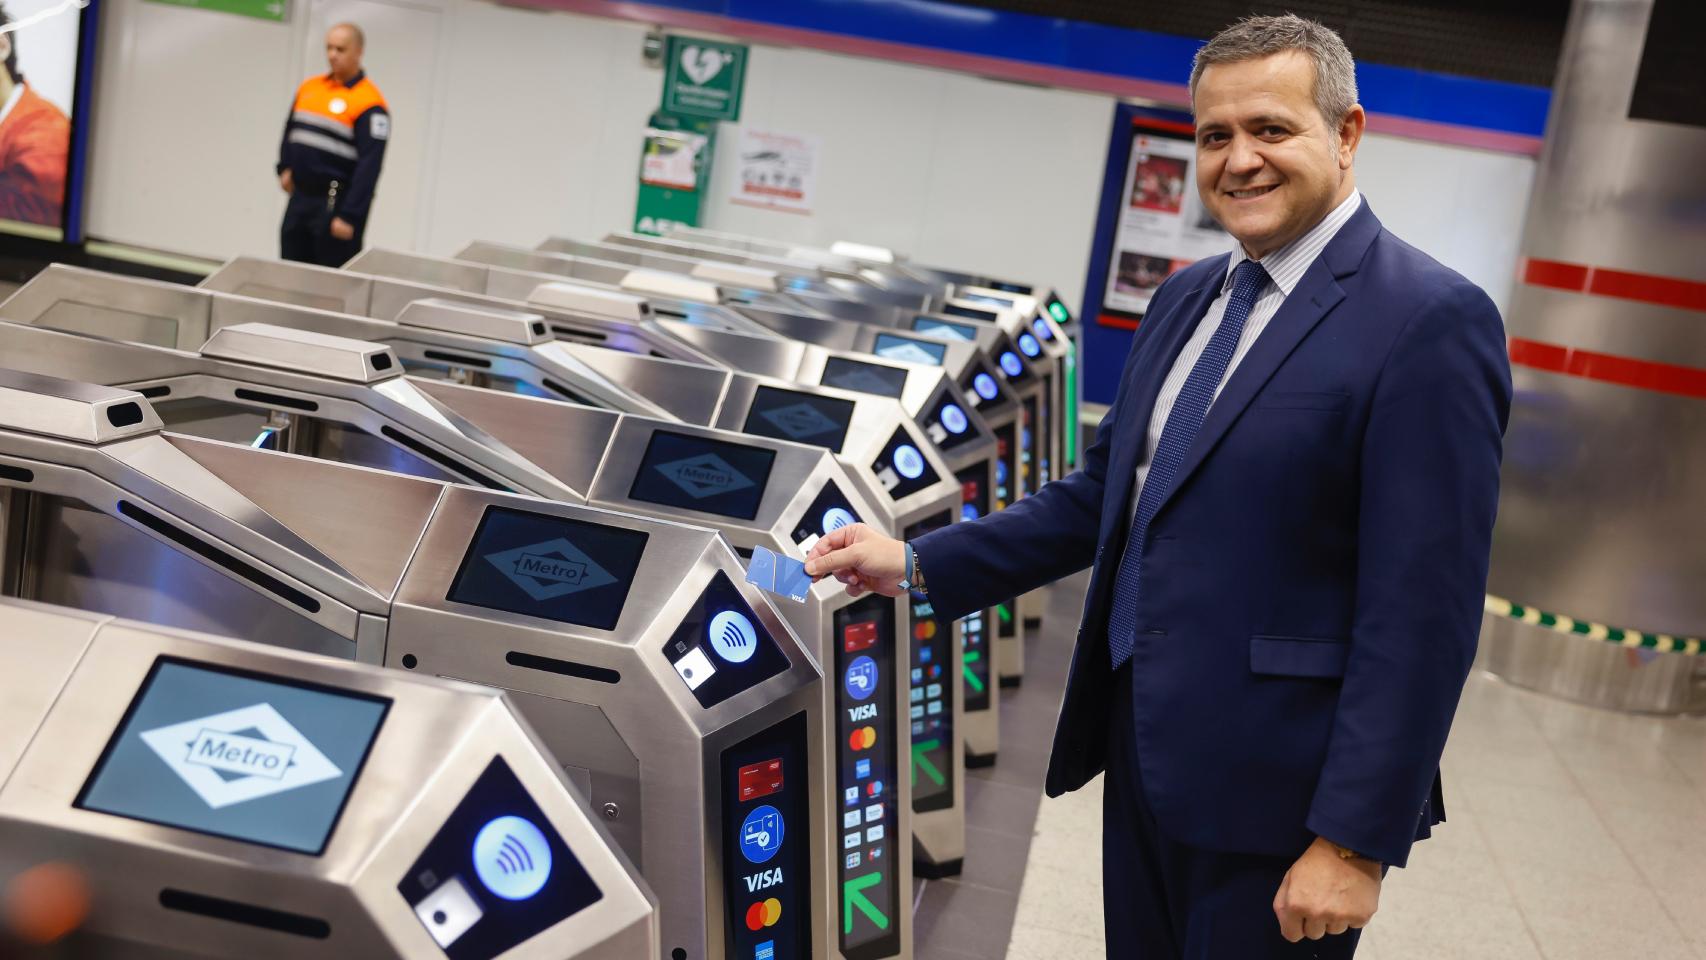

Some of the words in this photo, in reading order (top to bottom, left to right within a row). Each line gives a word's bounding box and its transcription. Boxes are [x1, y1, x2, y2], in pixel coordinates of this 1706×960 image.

[684, 467, 725, 483] Metro
[523, 558, 577, 578] Metro
[847, 703, 878, 722] VISA
[200, 737, 280, 769] Metro
[742, 866, 784, 893] VISA
